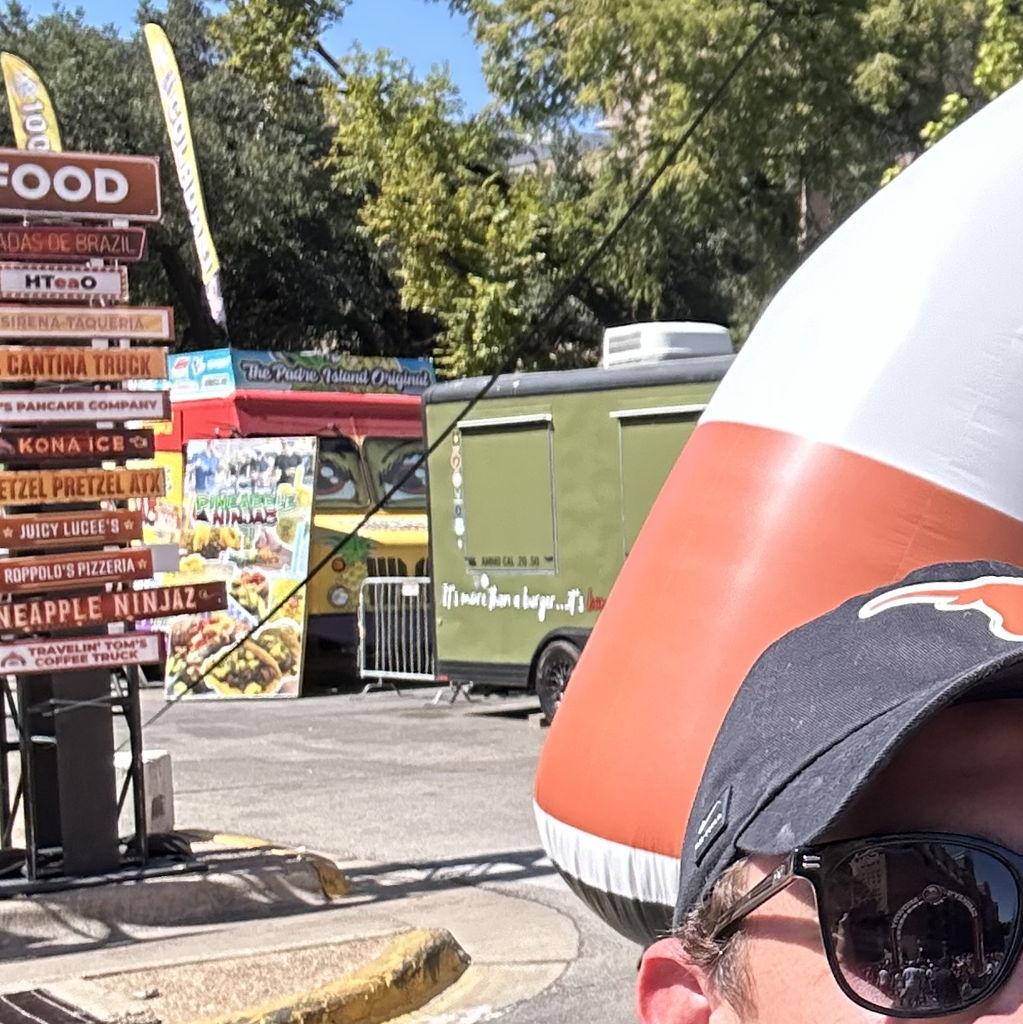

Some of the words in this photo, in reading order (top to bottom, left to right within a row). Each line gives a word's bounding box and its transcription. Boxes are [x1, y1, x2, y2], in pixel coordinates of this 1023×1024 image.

[48, 234, 69, 251] DE
[75, 234, 133, 253] BRAZIL
[25, 274, 97, 289] HTeaO
[1, 314, 60, 328] SIRENA
[67, 315, 145, 328] TAQUERIA
[7, 350, 87, 376] CANTINA
[93, 352, 151, 376] TRUCK
[242, 361, 271, 382] The
[322, 366, 369, 386] Island
[370, 368, 431, 391] Original
[16, 402, 85, 413] PANCAKE
[89, 400, 157, 411] COMPANY
[18, 437, 81, 454] KONA
[52, 472, 124, 498] PRETZEL
[130, 469, 163, 496] ATX
[20, 521, 58, 540] JUICY
[63, 518, 120, 538] LUCEE'S
[4, 563, 75, 584] ROPPOLO'S
[78, 558, 135, 577] PIZZERIA
[0, 596, 103, 628] NEAPPLE
[115, 587, 197, 619] NINJAZ
[29, 641, 102, 657] TRAVELIN'
[104, 638, 148, 651] TOM'S
[35, 653, 89, 667] COFFEE
[92, 650, 138, 663] TRUCK
